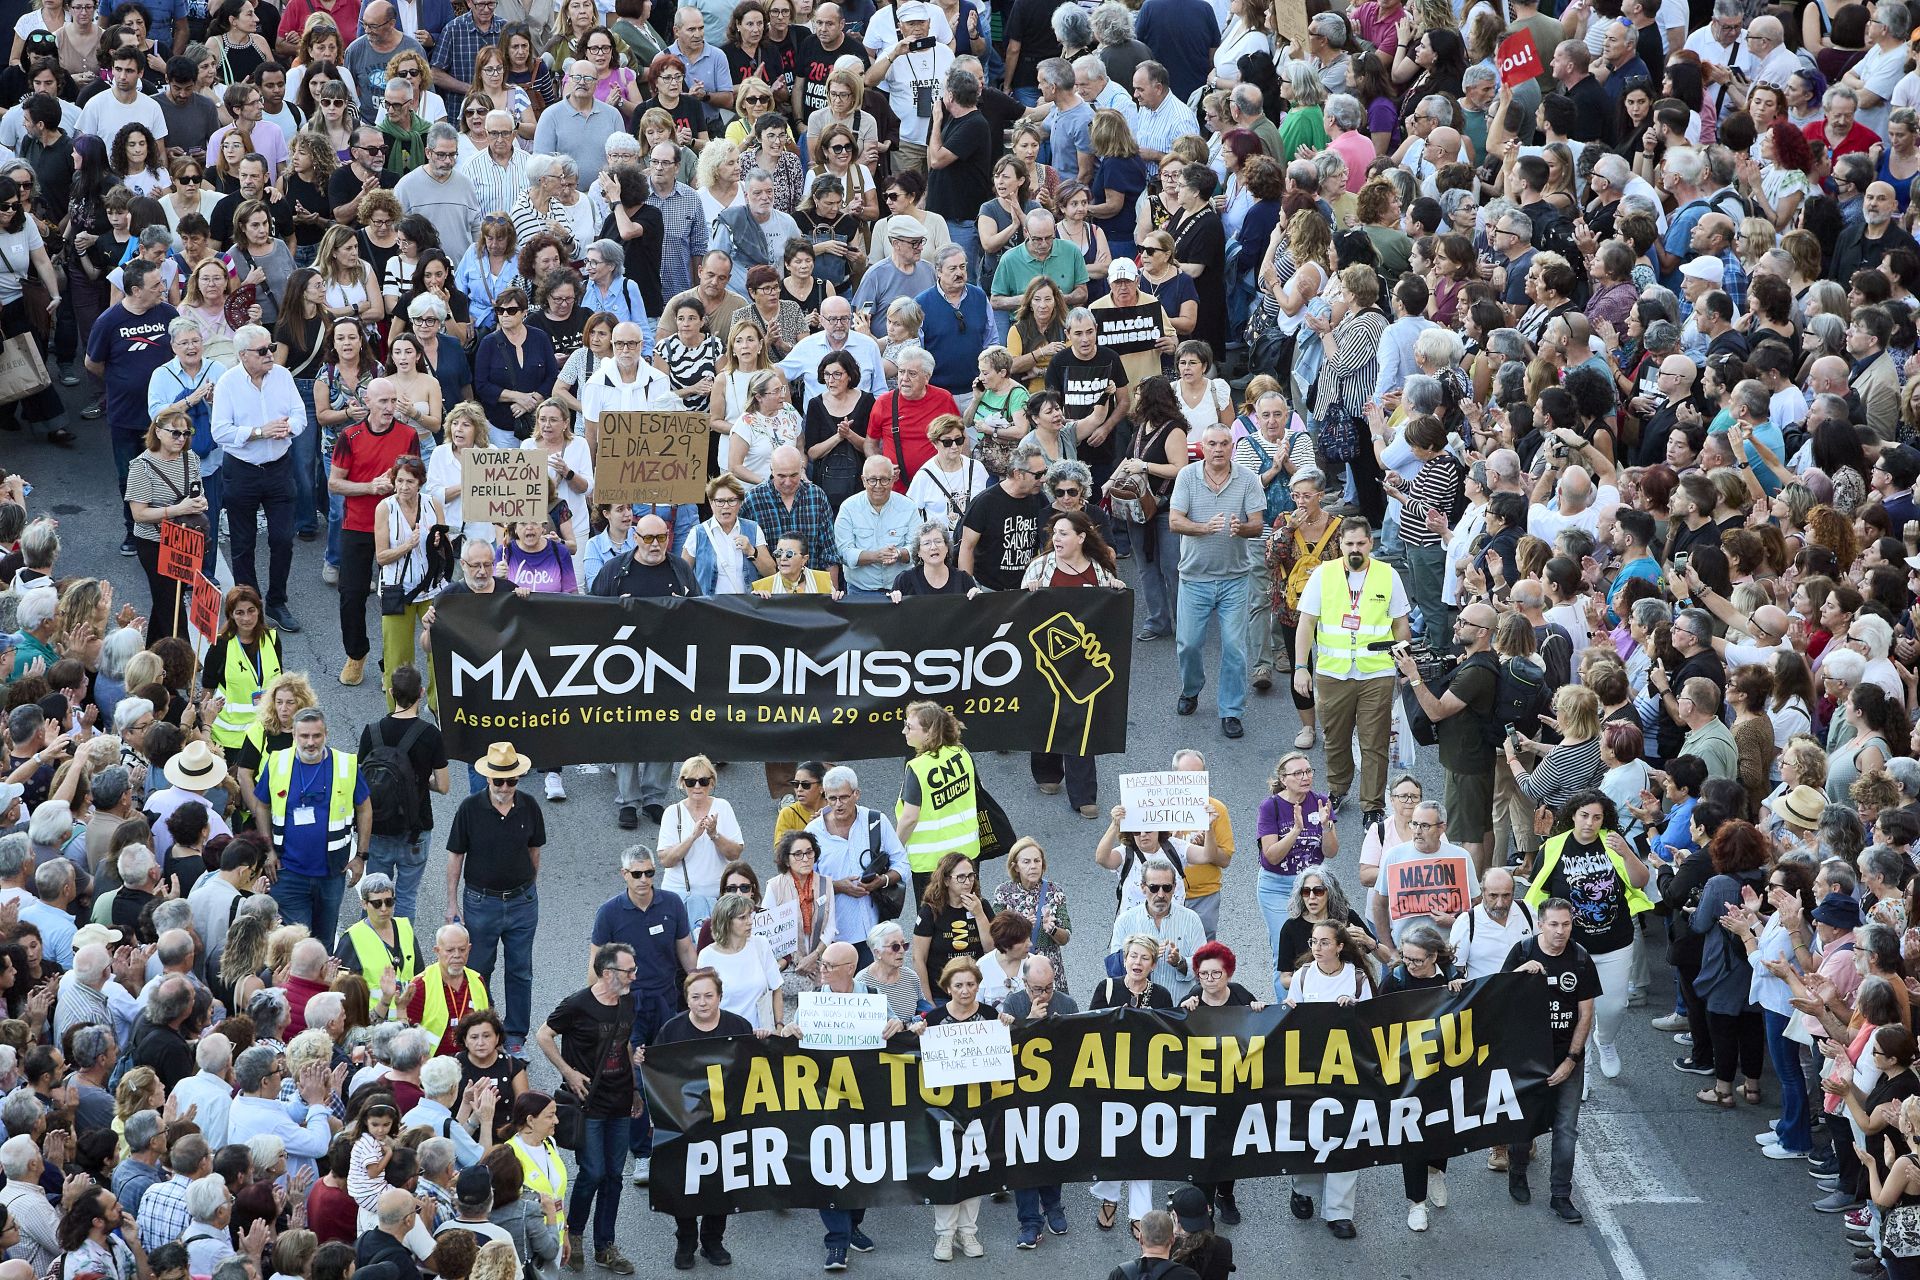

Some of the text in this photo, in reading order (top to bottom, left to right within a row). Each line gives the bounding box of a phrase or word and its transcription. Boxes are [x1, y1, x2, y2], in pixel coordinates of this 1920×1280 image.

[119, 322, 166, 338] Reebok
[1103, 315, 1154, 333] MAZÓN
[1097, 326, 1160, 346] DIMISSIÓ
[603, 413, 708, 435] ON ESTAVES
[601, 437, 621, 458] EL
[471, 451, 526, 465] VOTAR A
[484, 463, 540, 483] MAZÓN
[526, 483, 542, 496] DE
[489, 499, 541, 518] MORT
[1015, 514, 1038, 532] POBLE
[162, 523, 204, 559] PICANYA
[514, 558, 554, 593] hope.
[450, 624, 698, 701] MAZÓN
[727, 621, 1023, 698] DIMISSIÓ
[453, 696, 1021, 729] Associació Víctimes de la DANA 29 octe 2024
[926, 752, 966, 789] CNT
[933, 778, 970, 807] EN LUCHA
[1142, 809, 1196, 823] JUSTICIA
[1399, 859, 1456, 889] MAZÓN
[1398, 888, 1461, 914] DIMISSIÓ
[812, 996, 872, 1008] JUSTICIA
[813, 1020, 856, 1030] VALENCIA
[1561, 1011, 1573, 1020] PER
[953, 1036, 975, 1046] PARA
[922, 1049, 949, 1062] MIGUEL
[952, 1047, 958, 1058] Y
[960, 1046, 983, 1058] SARA
[706, 1063, 725, 1123] I
[740, 1055, 865, 1116] ARA
[1068, 1032, 1266, 1094] ALCEM
[1284, 1028, 1359, 1087] LA
[1371, 1007, 1490, 1086] VEU,
[941, 1060, 967, 1071] PADRE
[972, 1058, 979, 1067] E
[684, 1067, 1524, 1195] PER QUI JA NO POT ALÇAR-LA
